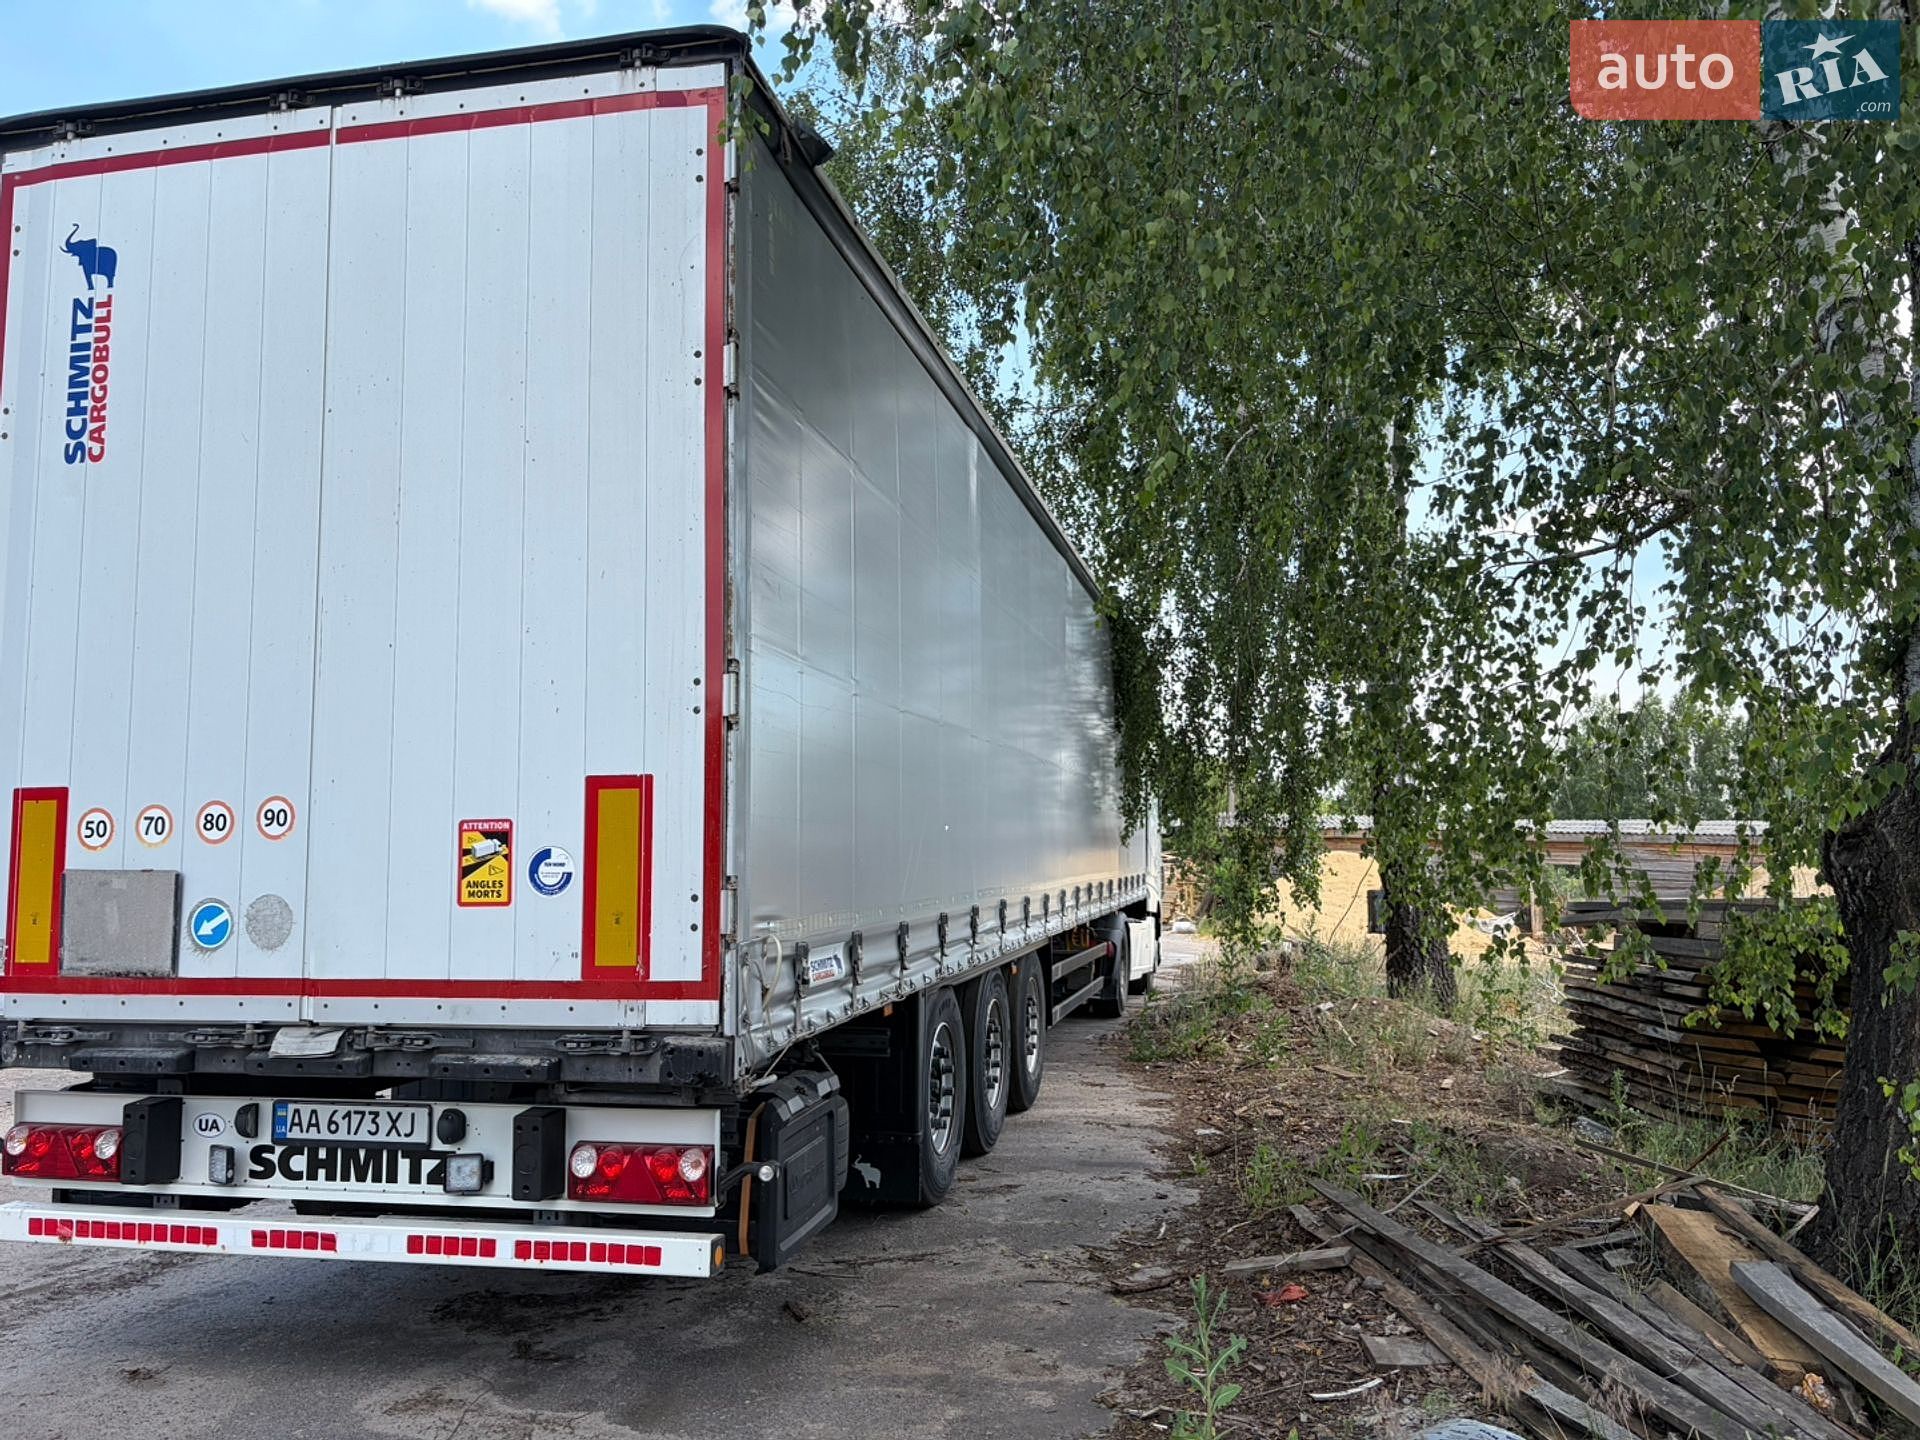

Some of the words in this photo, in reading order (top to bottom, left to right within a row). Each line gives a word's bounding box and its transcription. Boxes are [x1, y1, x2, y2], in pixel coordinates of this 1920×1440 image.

[64, 297, 94, 465] SCHMITZ
[88, 294, 113, 463] CARGOBULL
[143, 816, 166, 836] 70
[202, 813, 227, 832] 80
[263, 808, 288, 828] 90
[462, 822, 510, 831] ATTENTION
[84, 820, 108, 839] 50
[465, 880, 504, 889] ANGLES
[467, 889, 502, 899] MORTS
[198, 1118, 222, 1133] UA
[276, 1125, 286, 1133] UA
[288, 1107, 321, 1135] AA
[327, 1109, 380, 1137] 6173
[386, 1111, 415, 1138] XJ
